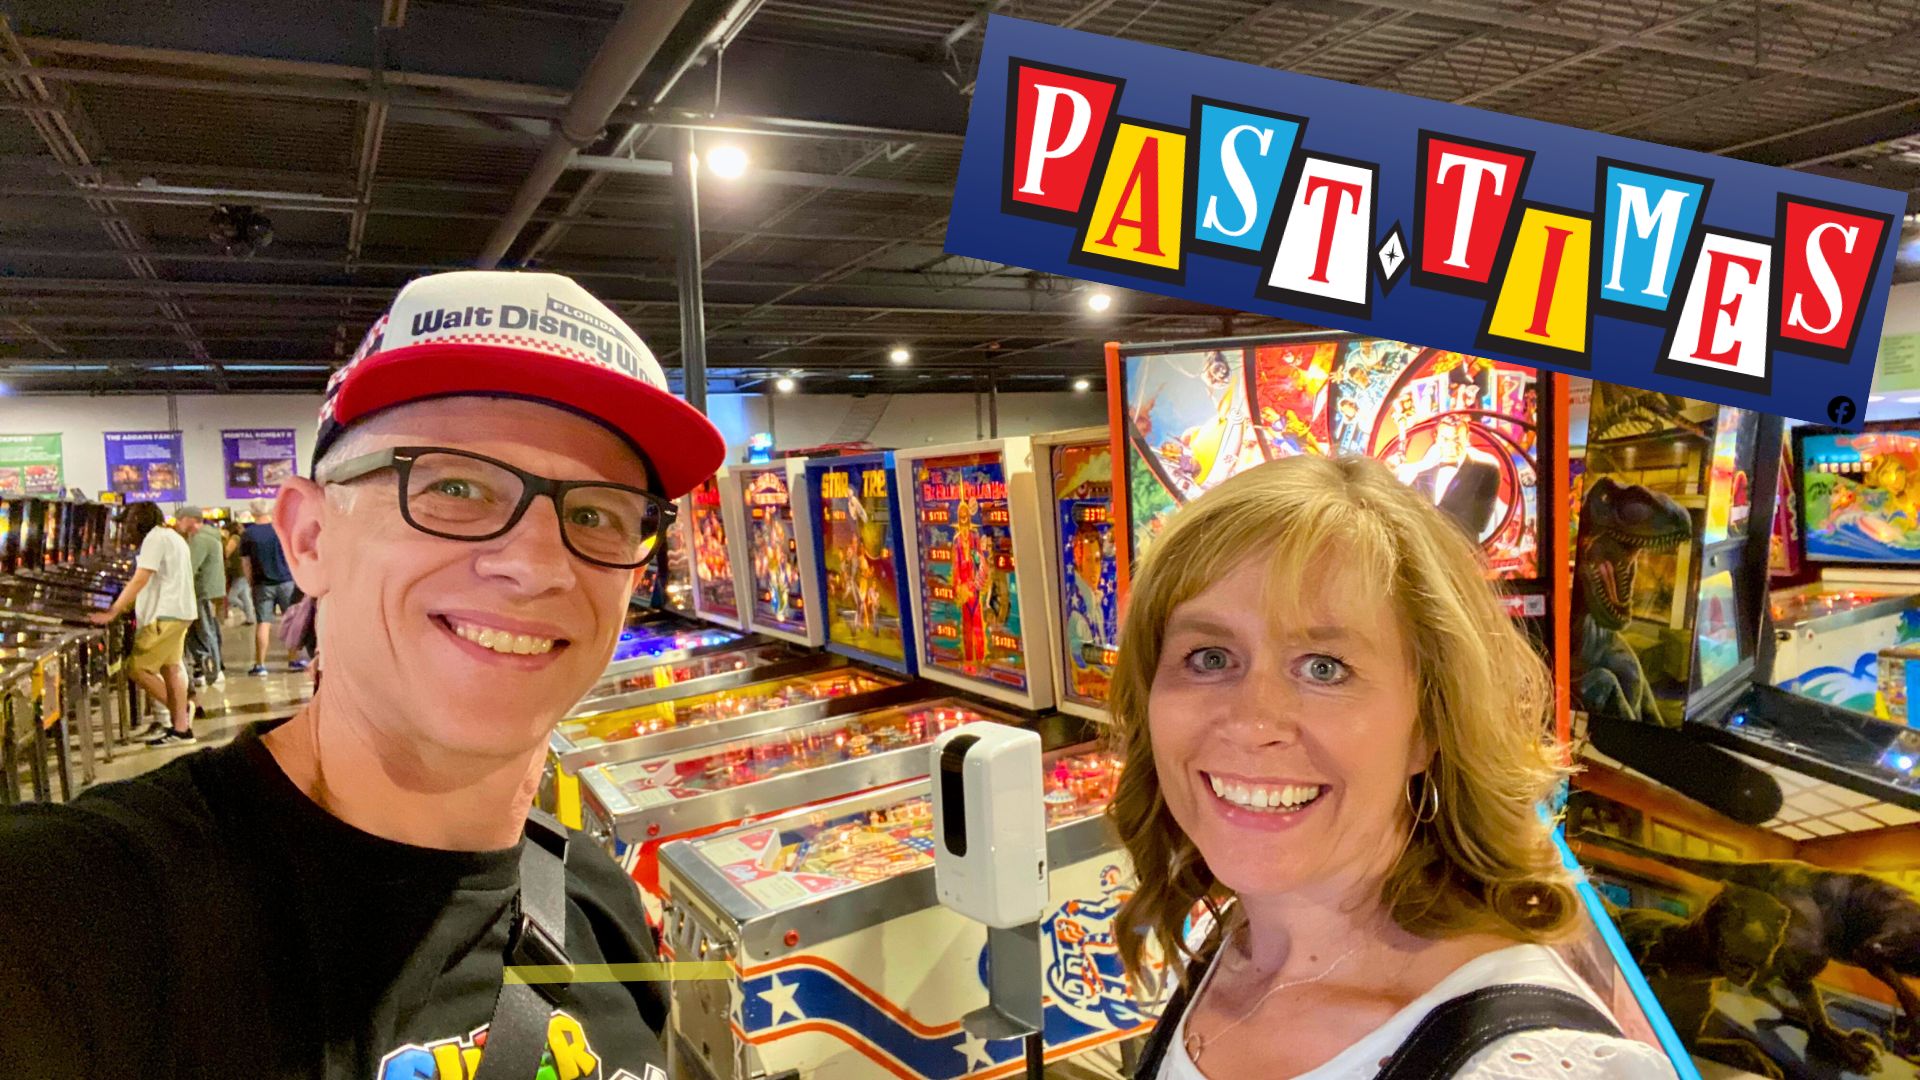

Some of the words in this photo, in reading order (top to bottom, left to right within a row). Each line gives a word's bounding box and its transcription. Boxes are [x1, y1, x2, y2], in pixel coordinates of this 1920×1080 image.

[411, 306, 493, 336] Walt
[498, 304, 612, 363] Disney
[552, 302, 617, 335] FLORIDA
[822, 472, 849, 498] STAR
[862, 469, 888, 497] TRE
